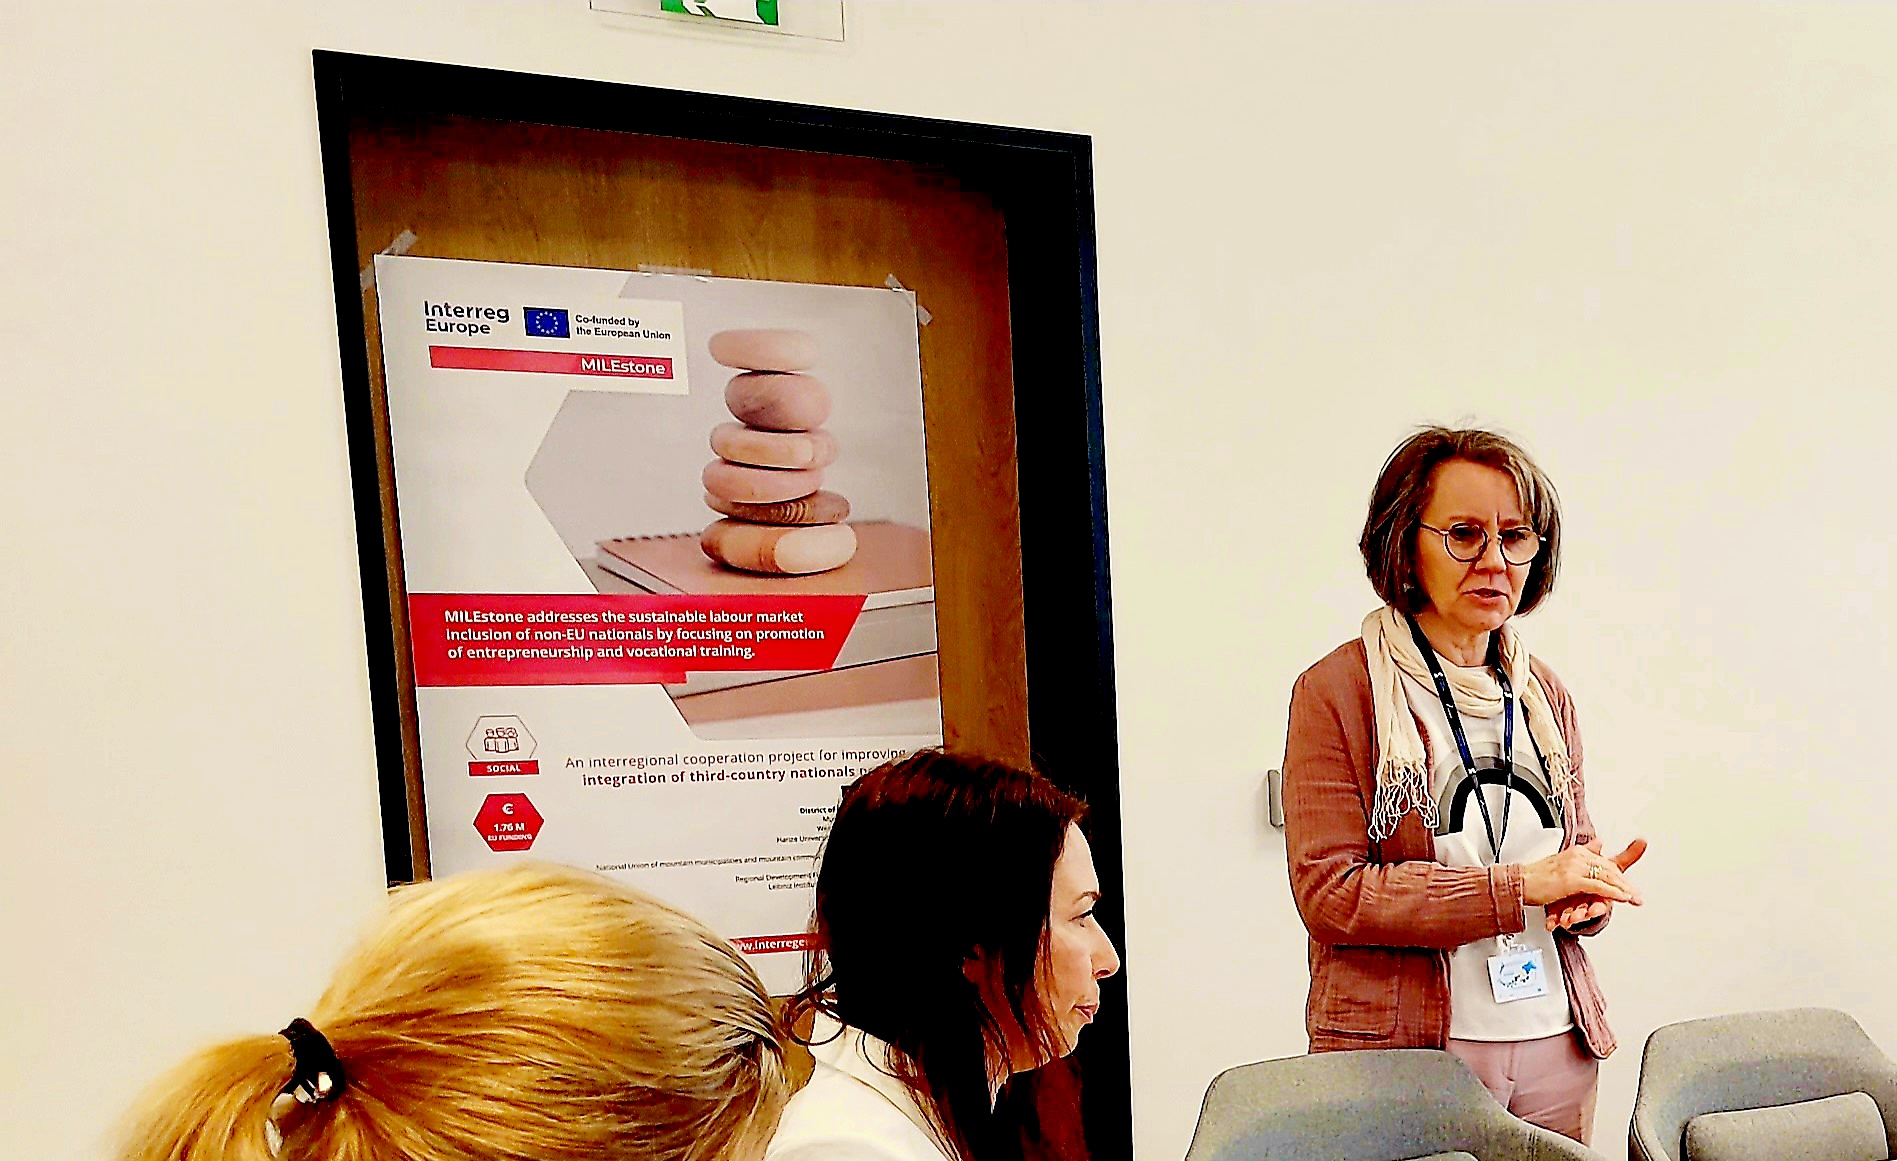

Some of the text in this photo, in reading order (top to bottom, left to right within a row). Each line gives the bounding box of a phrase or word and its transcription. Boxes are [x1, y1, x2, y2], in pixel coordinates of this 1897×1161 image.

[424, 301, 510, 323] Interreg
[426, 319, 491, 336] Europe
[575, 314, 640, 328] Co-funded by
[576, 326, 671, 340] the European Union
[581, 357, 666, 375] MILEstone
[445, 610, 804, 623] MILEstone addresses the sustainable labour market
[446, 628, 825, 643] inclusion of non-EU nationals by focusing on promotion
[448, 645, 756, 662] of entrepreneurship and vocational training.
[565, 757, 584, 768] An
[589, 753, 678, 770] interregional
[683, 751, 764, 767] cooperation
[769, 751, 815, 765] project
[819, 749, 838, 761] for
[486, 764, 521, 773] SOCIAL
[582, 771, 666, 788] integration
[671, 771, 686, 784] of
[690, 768, 786, 783] third-country
[790, 766, 856, 779] nationals
[515, 822, 525, 831] M
